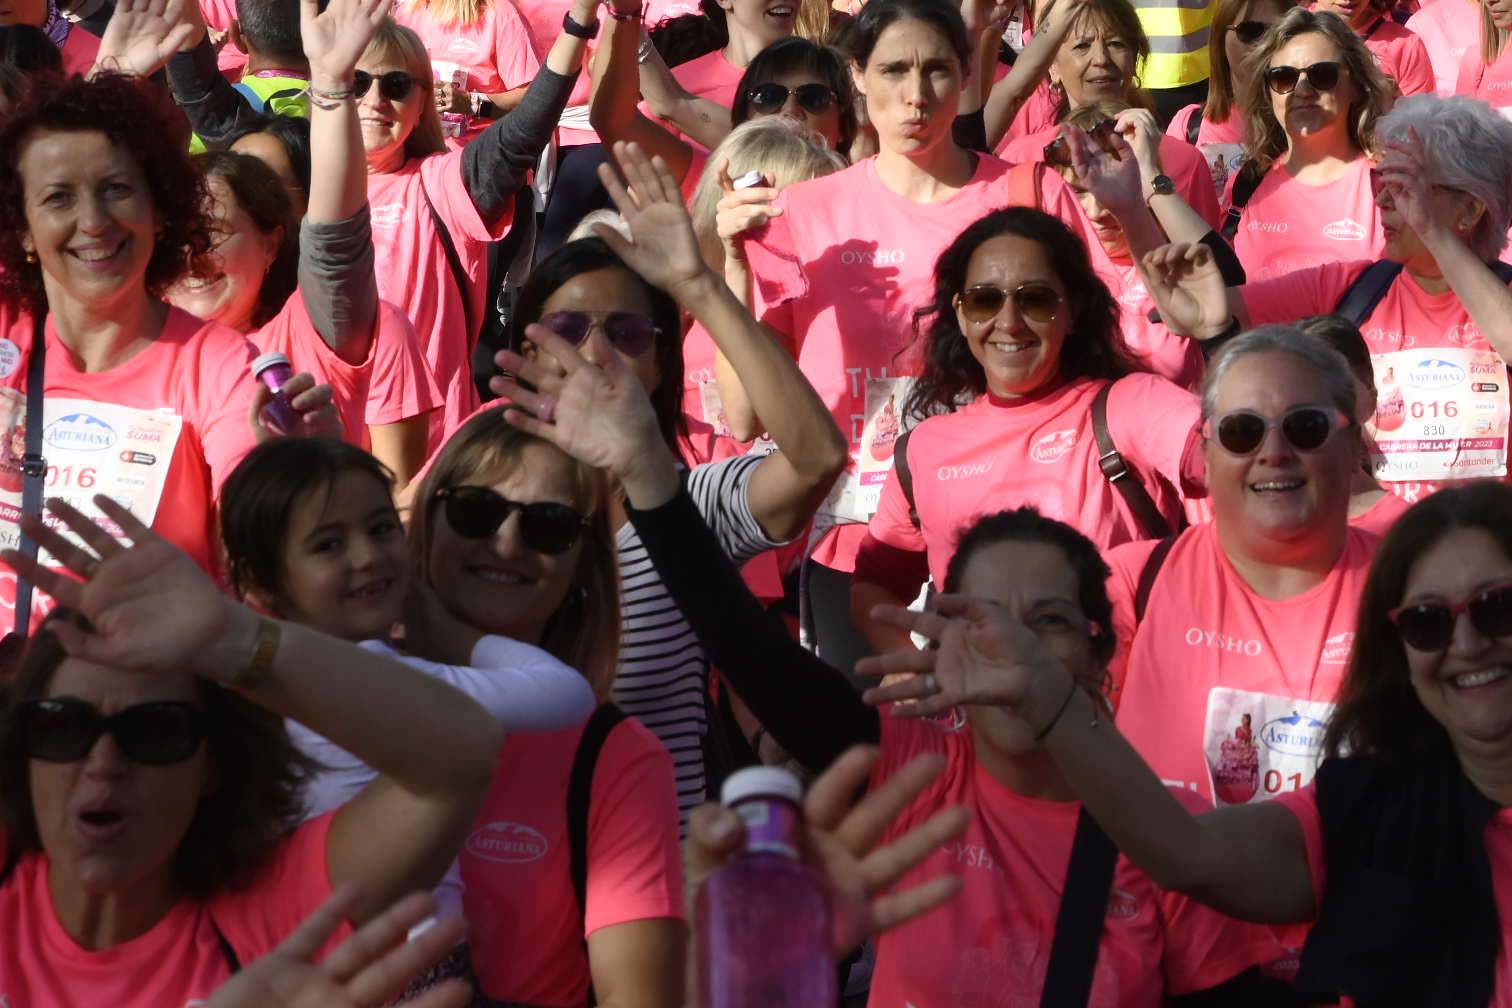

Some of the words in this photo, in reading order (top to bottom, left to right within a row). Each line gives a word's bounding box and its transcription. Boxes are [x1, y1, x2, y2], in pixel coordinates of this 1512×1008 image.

[840, 249, 905, 266] OYSHO
[1411, 400, 1458, 418] 016
[1423, 425, 1446, 436] 830
[937, 462, 993, 481] OYSHO
[1185, 626, 1263, 657] OYSHO
[1264, 768, 1304, 793] 01
